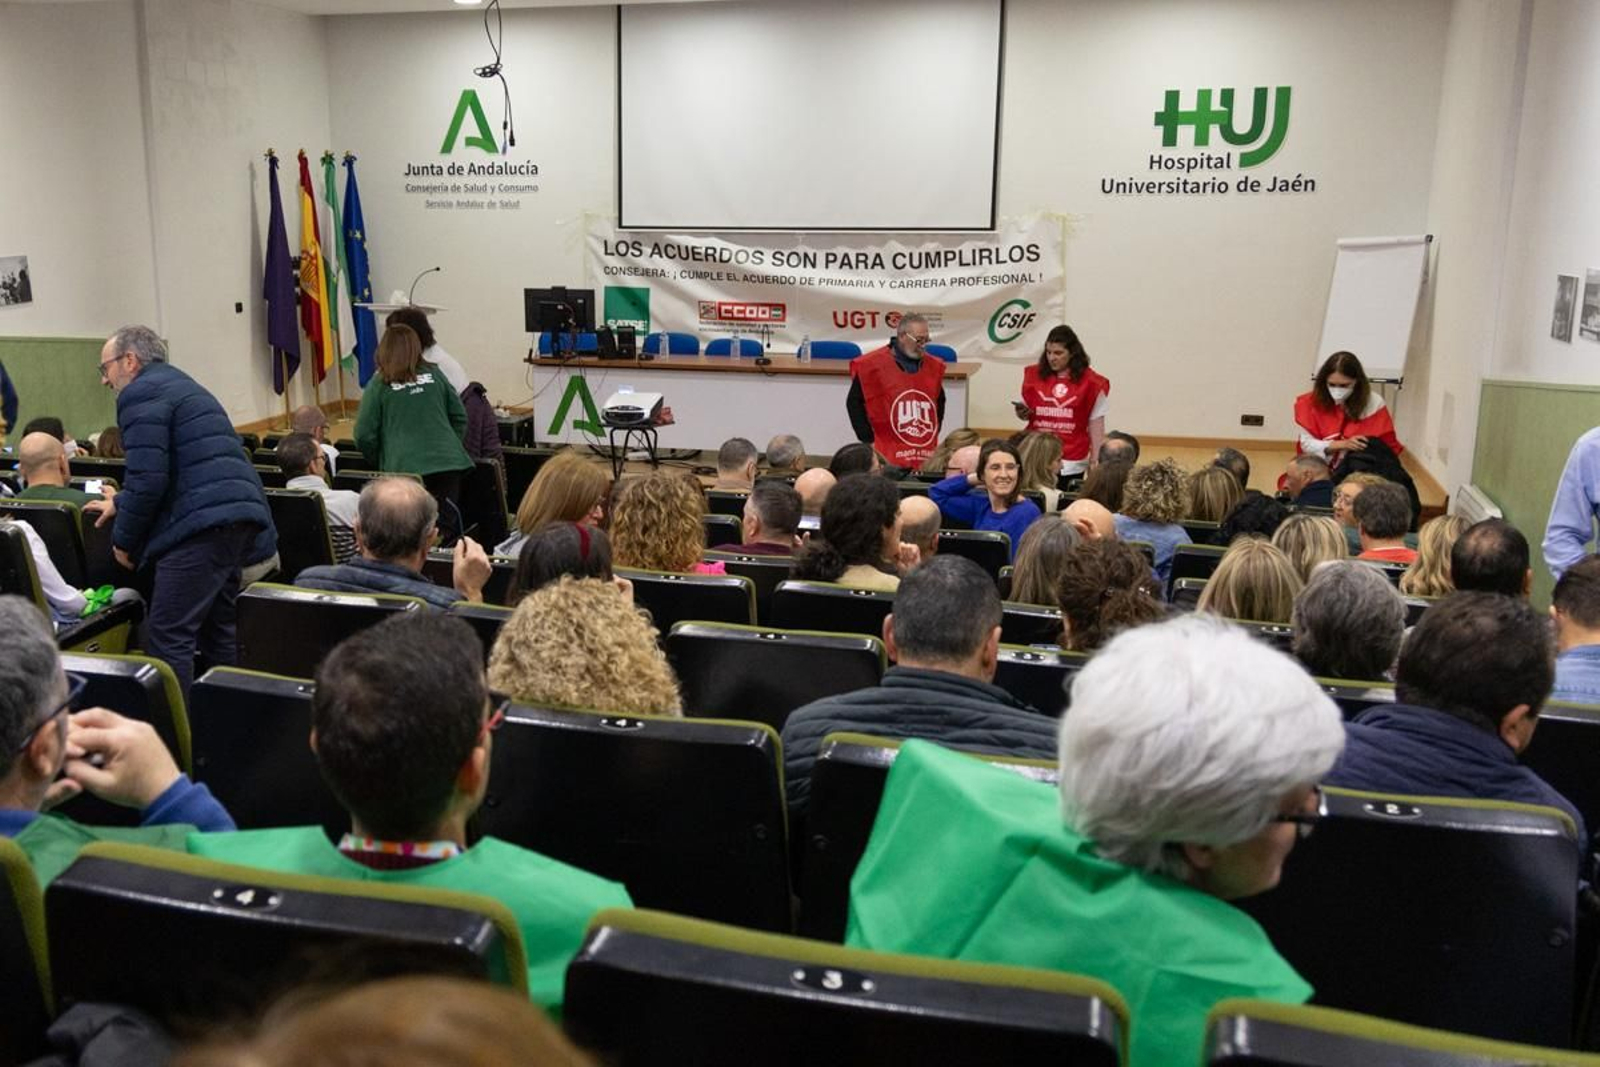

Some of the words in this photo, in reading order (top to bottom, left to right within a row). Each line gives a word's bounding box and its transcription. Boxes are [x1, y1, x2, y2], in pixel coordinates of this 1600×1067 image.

[405, 163, 443, 176] Junta
[447, 162, 464, 176] de
[467, 160, 539, 176] Andalucía
[1149, 152, 1231, 173] Hospital
[405, 183, 449, 195] Consejería
[451, 183, 461, 193] de
[464, 183, 487, 193] Salud
[490, 185, 496, 194] y
[498, 183, 539, 193] Consumo
[1101, 177, 1229, 194] Universitario
[1236, 176, 1261, 193] de
[1266, 173, 1316, 193] Jaén
[425, 200, 453, 209] Servicio
[456, 200, 484, 209] Andaluz
[487, 200, 496, 209] de
[500, 200, 520, 209] Salud
[604, 240, 643, 257] LOS
[650, 243, 764, 265] ACUERDOS
[771, 250, 817, 269] SON
[825, 252, 885, 270] PARA
[892, 243, 1041, 270] CUMPLIRLOS
[604, 266, 670, 278] CONSEJERA:
[680, 269, 723, 281] CUMPLE
[727, 271, 740, 282] EL
[743, 274, 797, 285] ACUERDO
[799, 276, 815, 286] DE
[818, 277, 875, 288] PRIMARIA
[878, 280, 885, 288] Y
[889, 279, 946, 289] CARRERA
[950, 273, 1035, 287] PROFESIONAL
[721, 305, 770, 318] CCOO
[833, 311, 880, 329] UGT
[998, 313, 1037, 329] CSIF
[898, 400, 931, 423] UGT
[1386, 803, 1400, 814] 2
[236, 889, 256, 906] 4
[821, 969, 843, 990] 3
